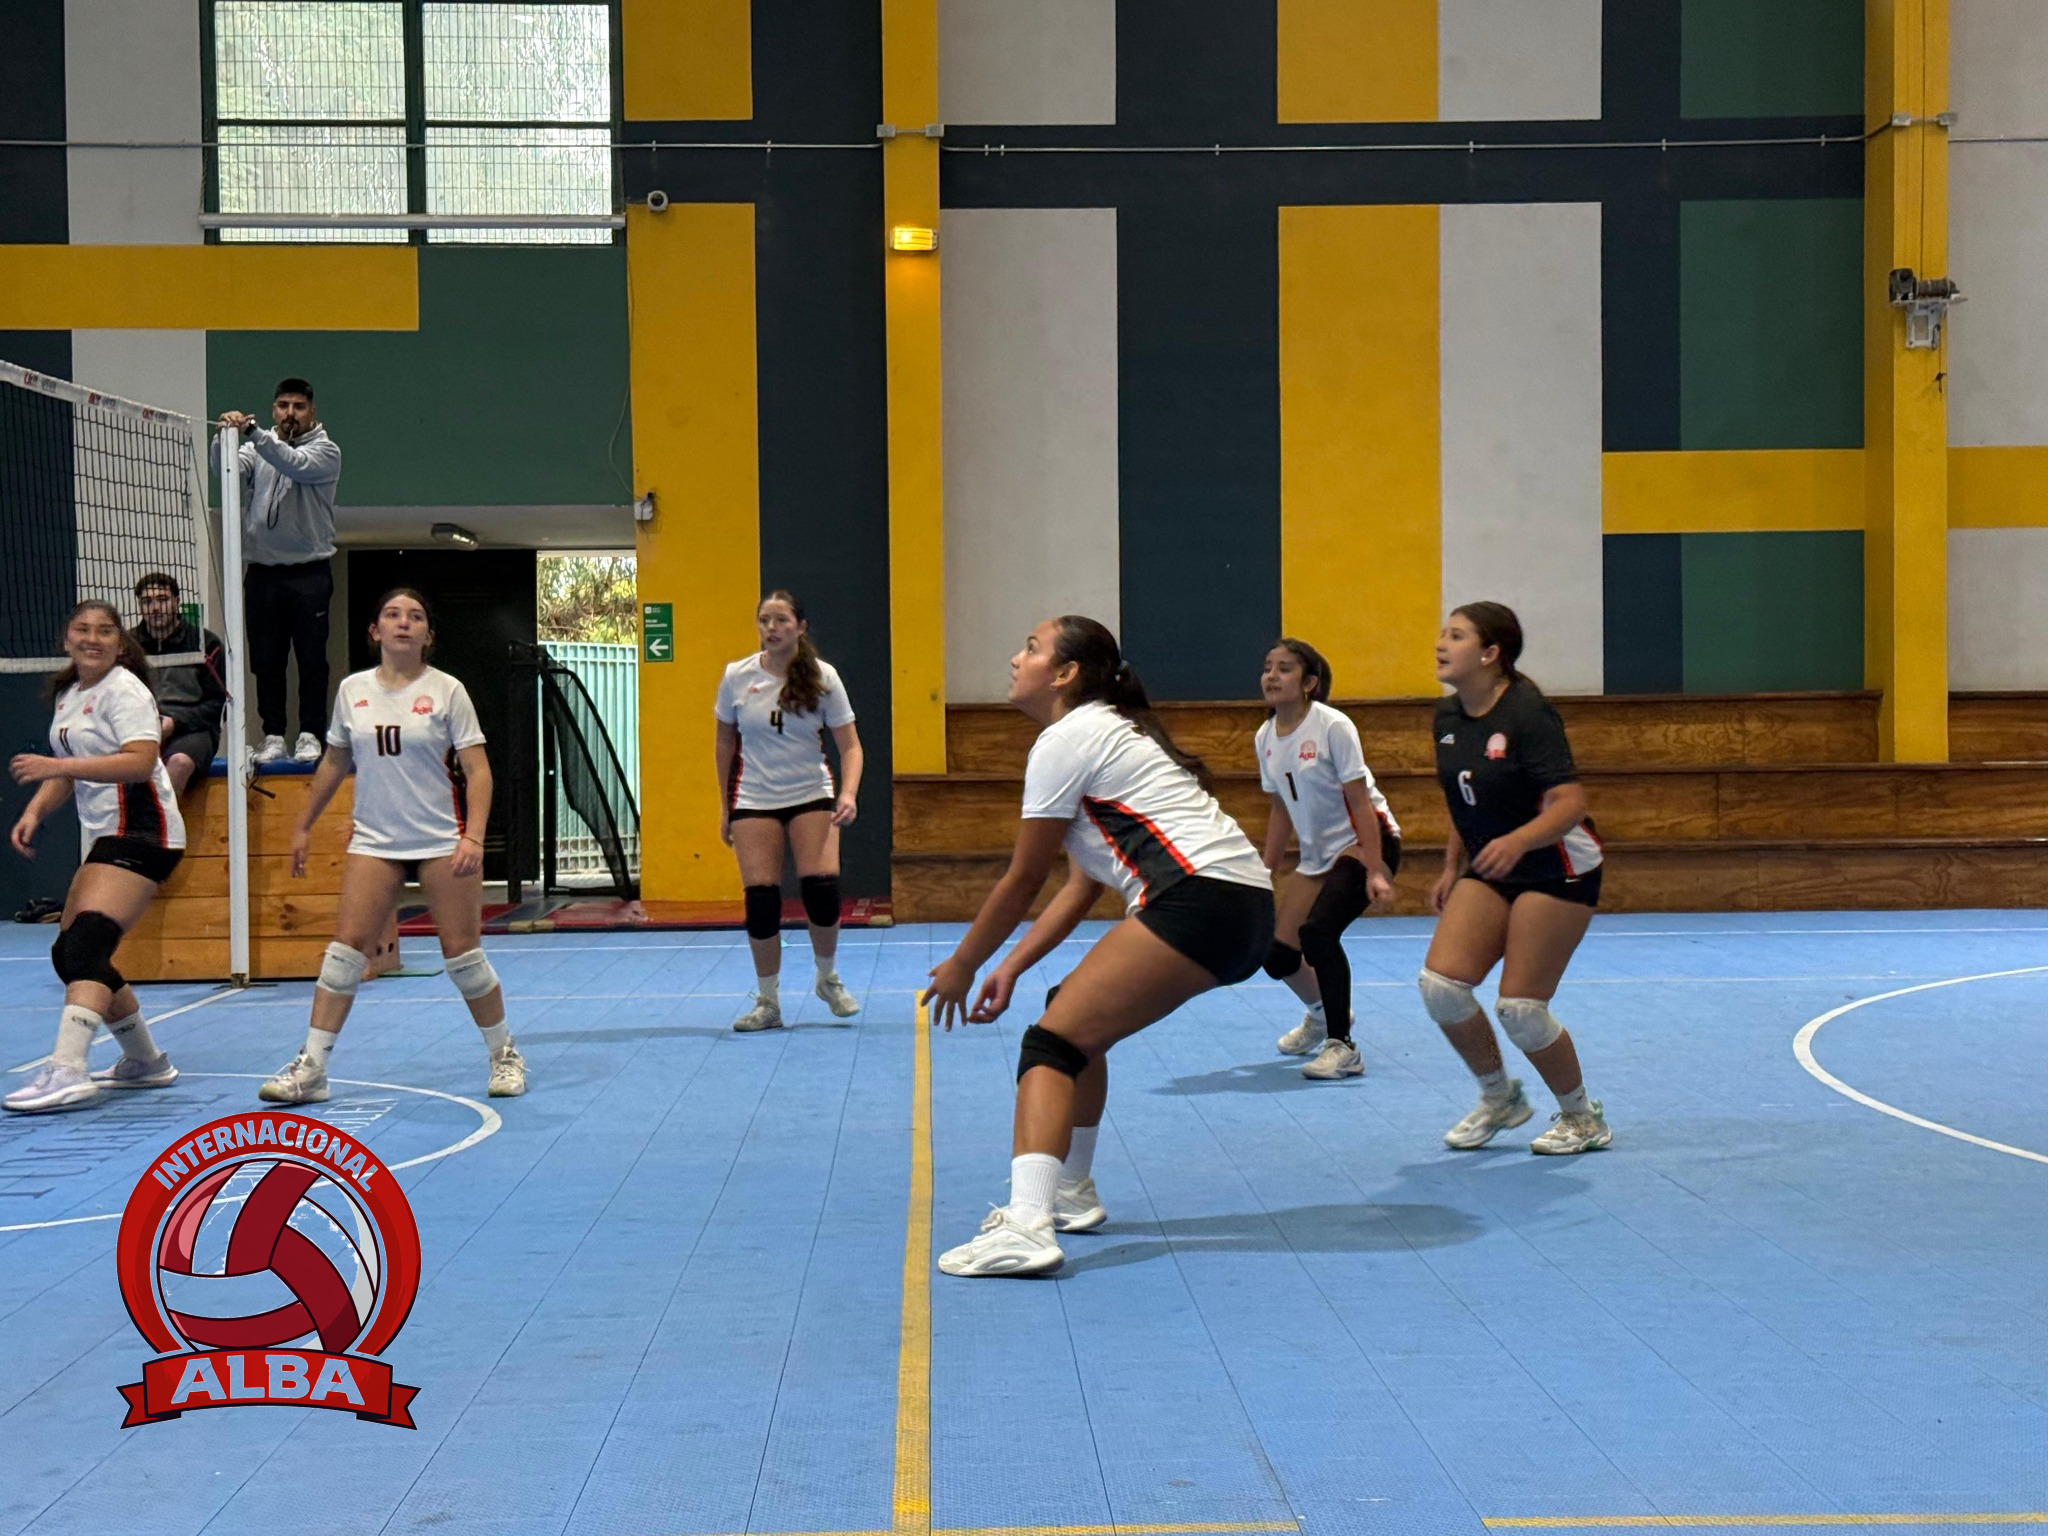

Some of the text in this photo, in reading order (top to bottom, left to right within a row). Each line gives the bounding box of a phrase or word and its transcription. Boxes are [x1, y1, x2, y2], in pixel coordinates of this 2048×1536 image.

[770, 710, 784, 735] 4
[375, 725, 402, 757] 10
[1285, 772, 1298, 802] 1
[1458, 770, 1477, 806] 6
